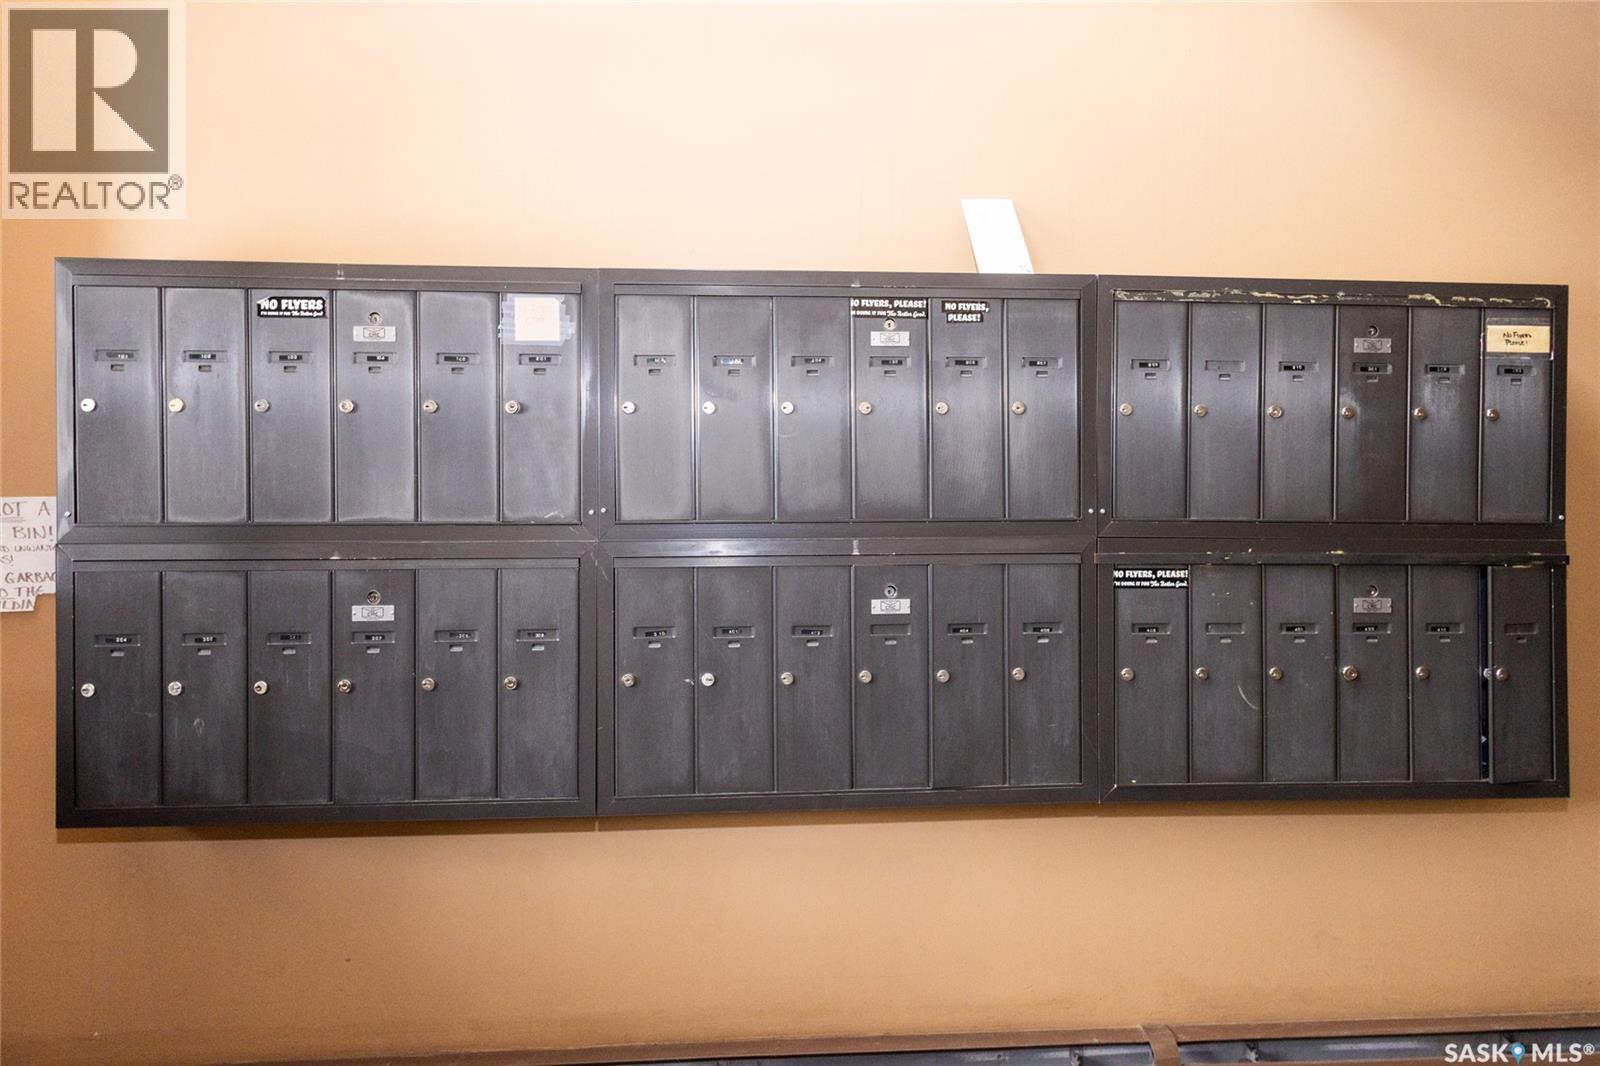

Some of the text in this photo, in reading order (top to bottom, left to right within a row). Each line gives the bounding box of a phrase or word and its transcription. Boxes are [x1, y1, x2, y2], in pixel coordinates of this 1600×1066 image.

[260, 299, 323, 310] NO FLYERS
[861, 299, 893, 308] FLYERS,
[893, 300, 927, 308] PLEASE!
[944, 302, 989, 312] NO FLYERS,
[947, 313, 981, 321] PLEASE!
[0, 501, 51, 516] OT A
[12, 526, 54, 542] BIN!
[1125, 570, 1156, 579] FLYERS,
[1156, 570, 1188, 578] PLEASE!
